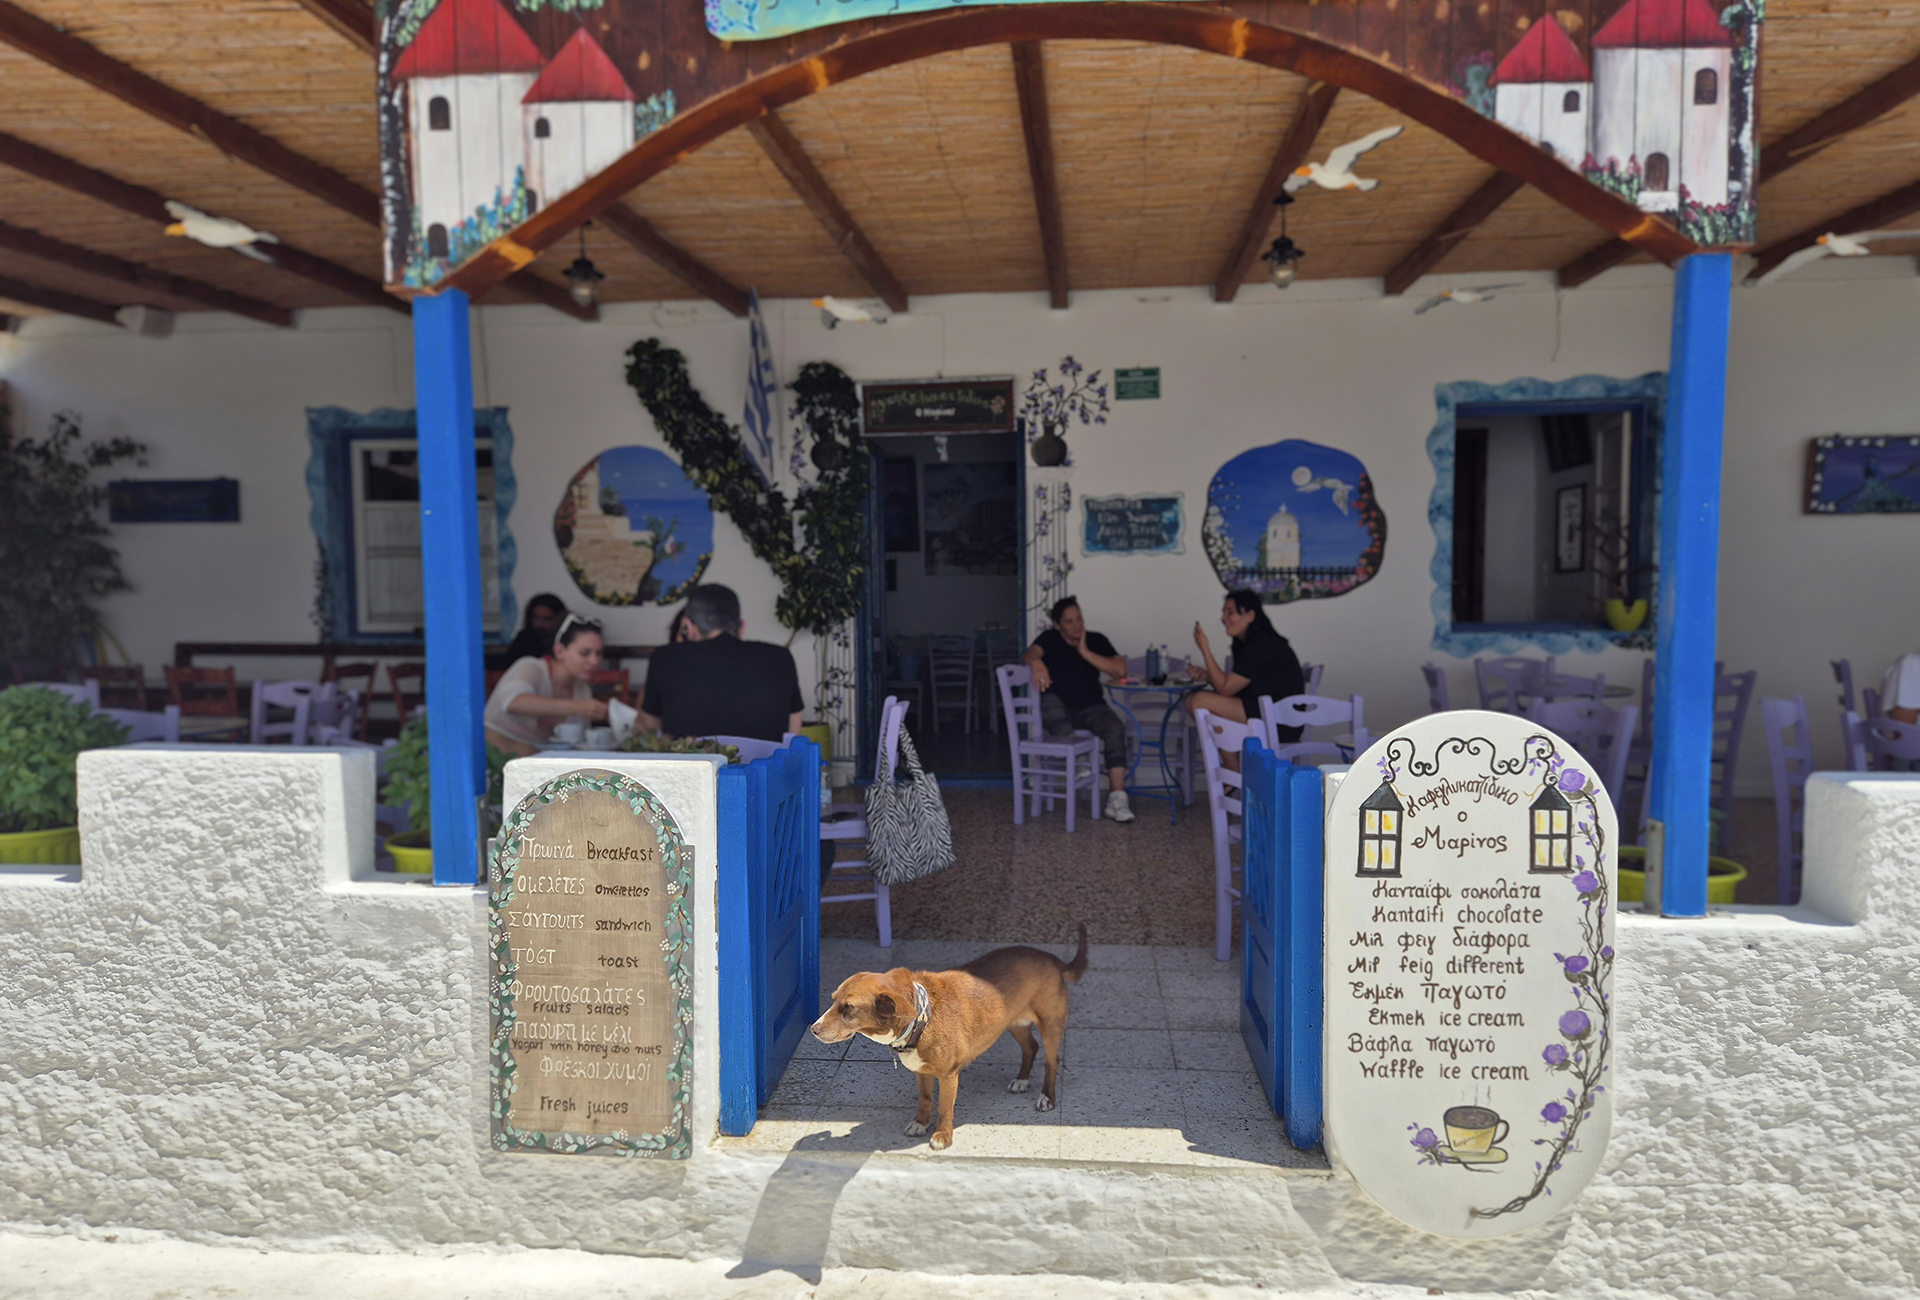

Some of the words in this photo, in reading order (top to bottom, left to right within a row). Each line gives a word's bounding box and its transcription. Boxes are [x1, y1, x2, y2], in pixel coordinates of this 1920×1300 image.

[517, 834, 574, 862] Πρωινά
[587, 840, 654, 861] Breakfast
[1411, 825, 1508, 858] Μαρίνος
[1461, 877, 1541, 899] σοκολάτα
[1371, 905, 1444, 923] Kantaifi
[1457, 904, 1543, 923] chocolate
[595, 919, 651, 932] sandwich
[1397, 932, 1437, 955] φειγ
[1453, 926, 1531, 955] διάφορα
[598, 954, 639, 968] toast
[1347, 957, 1381, 974] Mil
[1398, 956, 1433, 981] feig
[1446, 955, 1525, 975] different
[510, 980, 645, 1005] Φρουτοσαλάτες
[533, 1002, 572, 1013] Fruits
[587, 1003, 630, 1016] salads
[1368, 1008, 1425, 1026] Ekmek
[1440, 1011, 1461, 1026] ice
[1468, 1012, 1525, 1027] cream
[577, 1041, 608, 1059] honey
[635, 1044, 662, 1055] nuts
[1348, 1033, 1413, 1059] Βάφλα
[1425, 1036, 1495, 1060] παγωτό
[1359, 1060, 1424, 1079] Waffle
[1440, 1063, 1461, 1079] ice
[1471, 1064, 1529, 1080] cream
[540, 1095, 576, 1111] Fresh
[586, 1101, 629, 1119] juices
